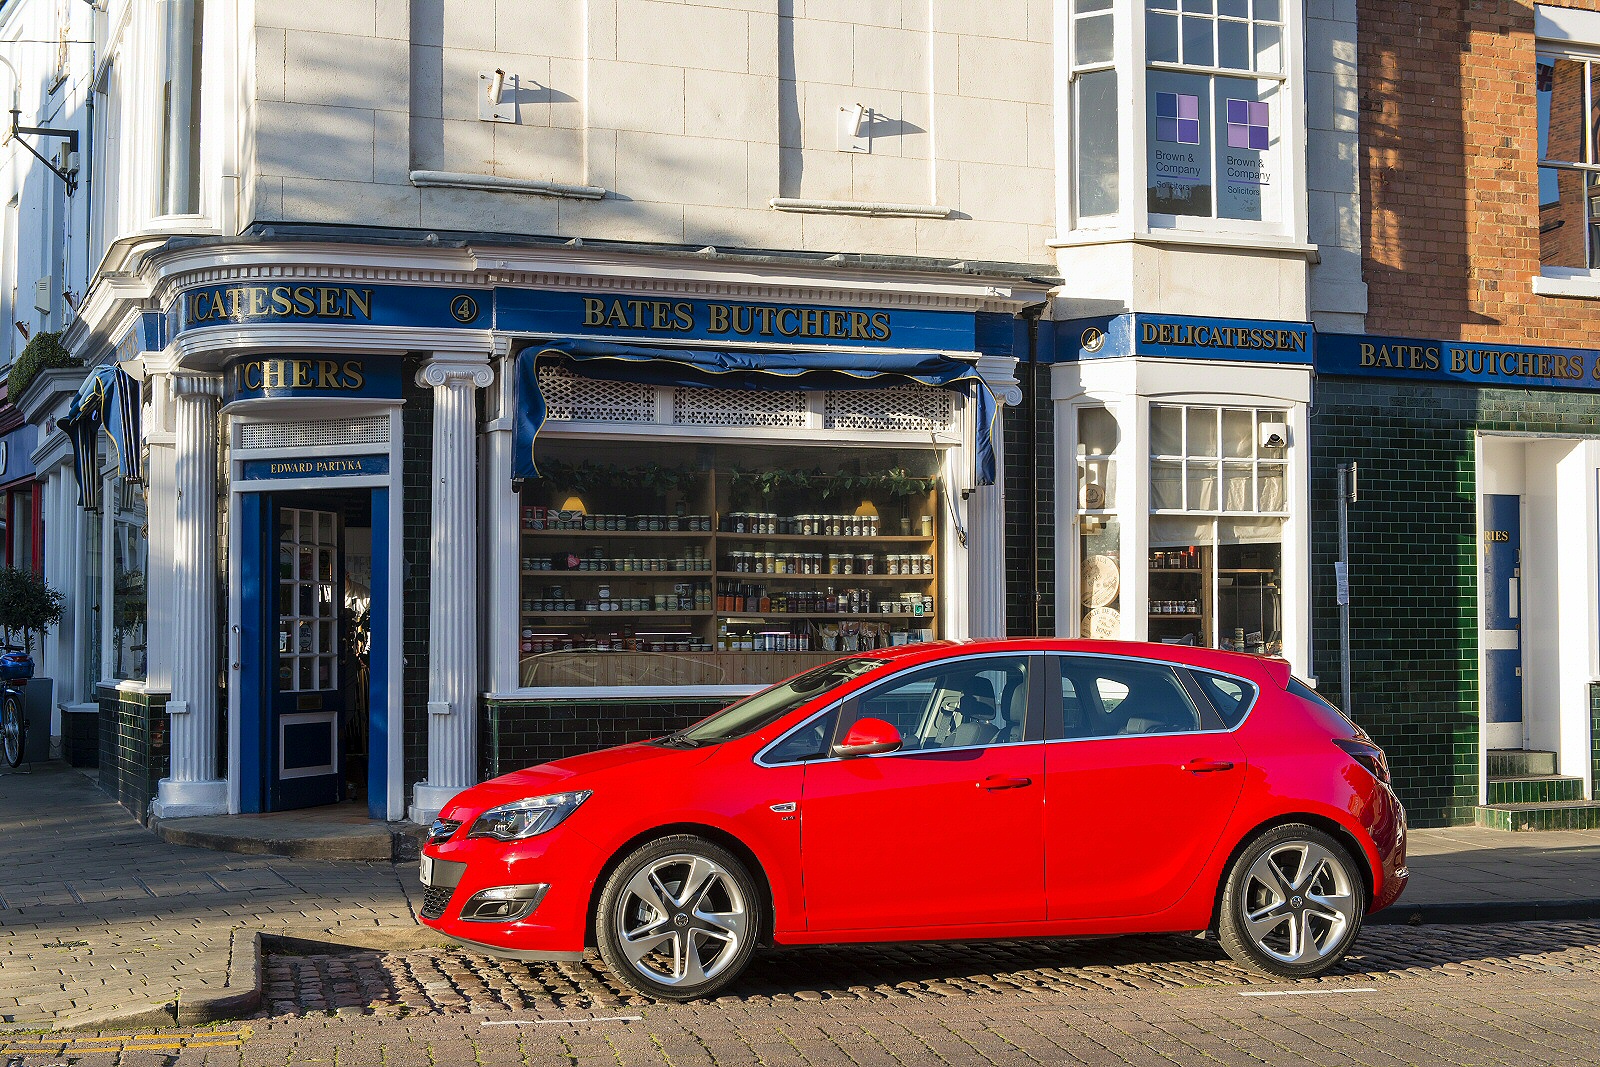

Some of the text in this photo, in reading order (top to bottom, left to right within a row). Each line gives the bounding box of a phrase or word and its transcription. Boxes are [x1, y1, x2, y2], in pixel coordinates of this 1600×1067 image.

[1155, 150, 1194, 162] Brown &
[1227, 156, 1265, 168] Brown &
[1156, 162, 1201, 176] Company
[1227, 168, 1270, 182] Company
[1227, 186, 1260, 196] Solicitors
[582, 297, 891, 341] BATES BUTCHERS
[1142, 323, 1307, 351] DELICATESSEN
[1359, 343, 1440, 371] BATES
[1450, 348, 1584, 380] BUTCHERS
[271, 460, 362, 474] EDWARD PARTYKA
